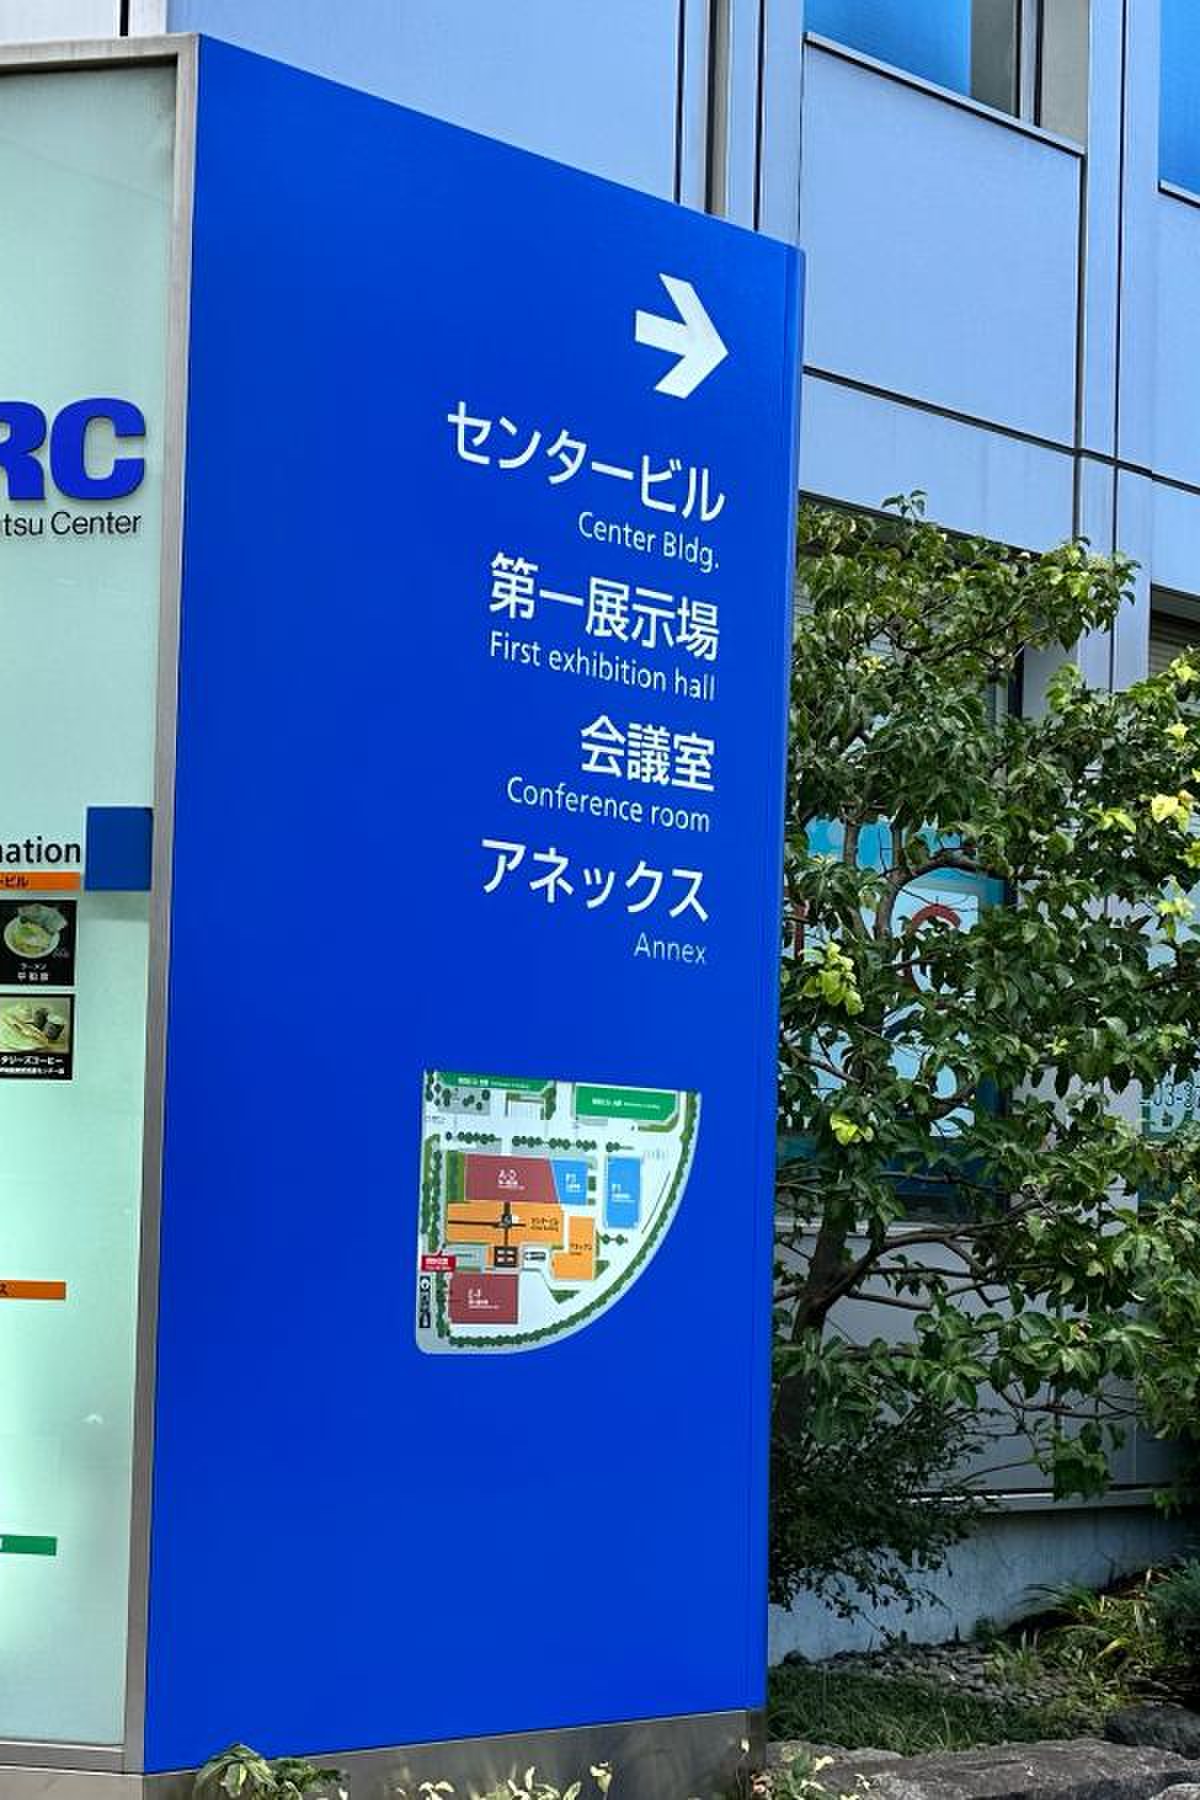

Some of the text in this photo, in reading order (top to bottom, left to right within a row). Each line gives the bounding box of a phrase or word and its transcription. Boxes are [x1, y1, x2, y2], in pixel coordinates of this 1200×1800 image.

[448, 401, 726, 523] センタービル
[50, 510, 141, 536] Center
[578, 511, 720, 574] Center Bldg.
[489, 552, 720, 661] 第一展示場
[490, 631, 715, 701] First exhibition hall
[580, 714, 715, 792] 会議室
[507, 776, 710, 832] Conference room
[481, 838, 709, 922] アネックス
[634, 932, 706, 964] Annex
